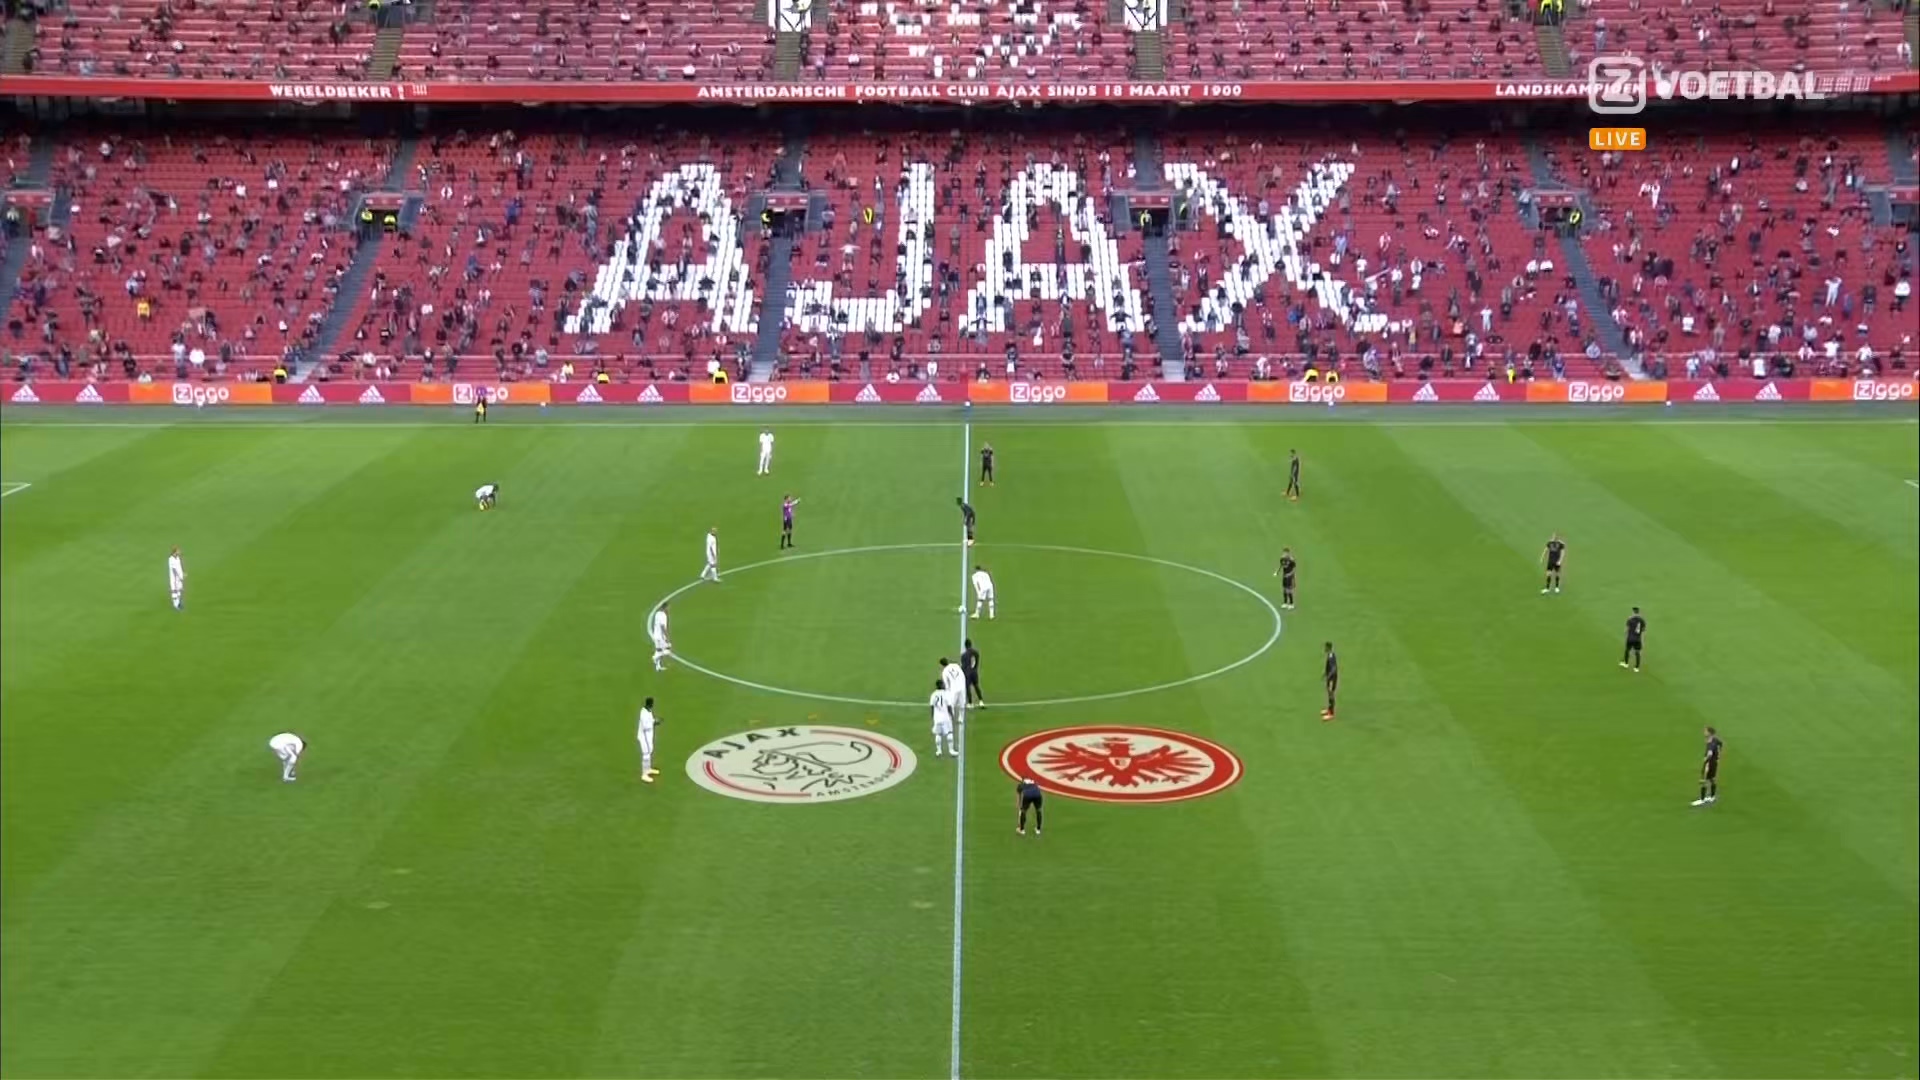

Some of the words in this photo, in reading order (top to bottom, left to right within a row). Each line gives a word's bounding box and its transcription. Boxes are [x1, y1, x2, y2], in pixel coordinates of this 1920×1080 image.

[269, 84, 392, 98] WERELDBEKER
[697, 84, 846, 98] AMSTERDAMSCHE
[855, 84, 940, 98] FOOTBALL
[946, 84, 990, 98] CLUB
[996, 84, 1041, 99] AJAX
[1047, 84, 1097, 97] SINDS
[1104, 84, 1123, 97] 18
[1129, 84, 1192, 97] MAART
[1202, 84, 1243, 97] 1900
[563, 162, 1396, 333] AJAX
